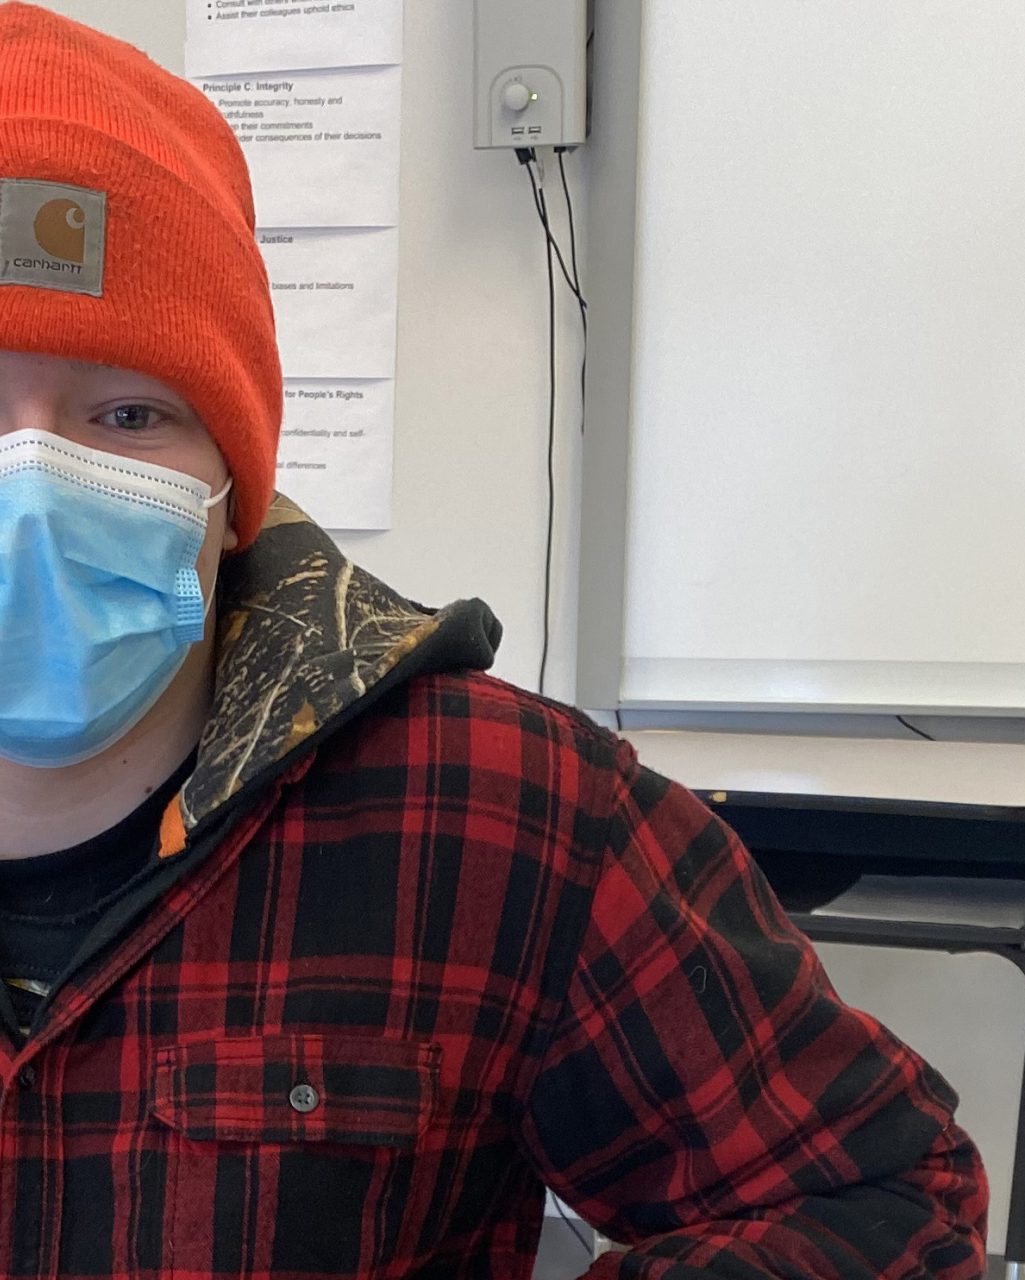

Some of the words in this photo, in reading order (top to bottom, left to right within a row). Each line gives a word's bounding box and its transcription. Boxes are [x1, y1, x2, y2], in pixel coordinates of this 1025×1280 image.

[241, 10, 258, 18] their
[259, 8, 301, 17] colleagues
[303, 5, 330, 14] uphold
[202, 82, 242, 93] Principle
[256, 81, 294, 92] Integrity
[218, 98, 252, 107] Promote
[294, 97, 327, 107] honesty
[327, 96, 343, 105] and
[241, 122, 258, 130] their
[260, 121, 313, 130] commitments
[255, 132, 313, 142] consequences
[314, 131, 323, 141] of
[323, 131, 342, 140] their
[343, 130, 382, 140] decisions
[260, 234, 294, 244] Justice
[13, 258, 83, 275] carhartt
[271, 281, 297, 291] biases
[299, 281, 314, 290] and
[315, 281, 354, 290] limitations
[284, 390, 296, 398] for
[298, 390, 334, 400] People's
[335, 390, 364, 401] Rights
[333, 429, 348, 438] and
[286, 461, 327, 470] differences
